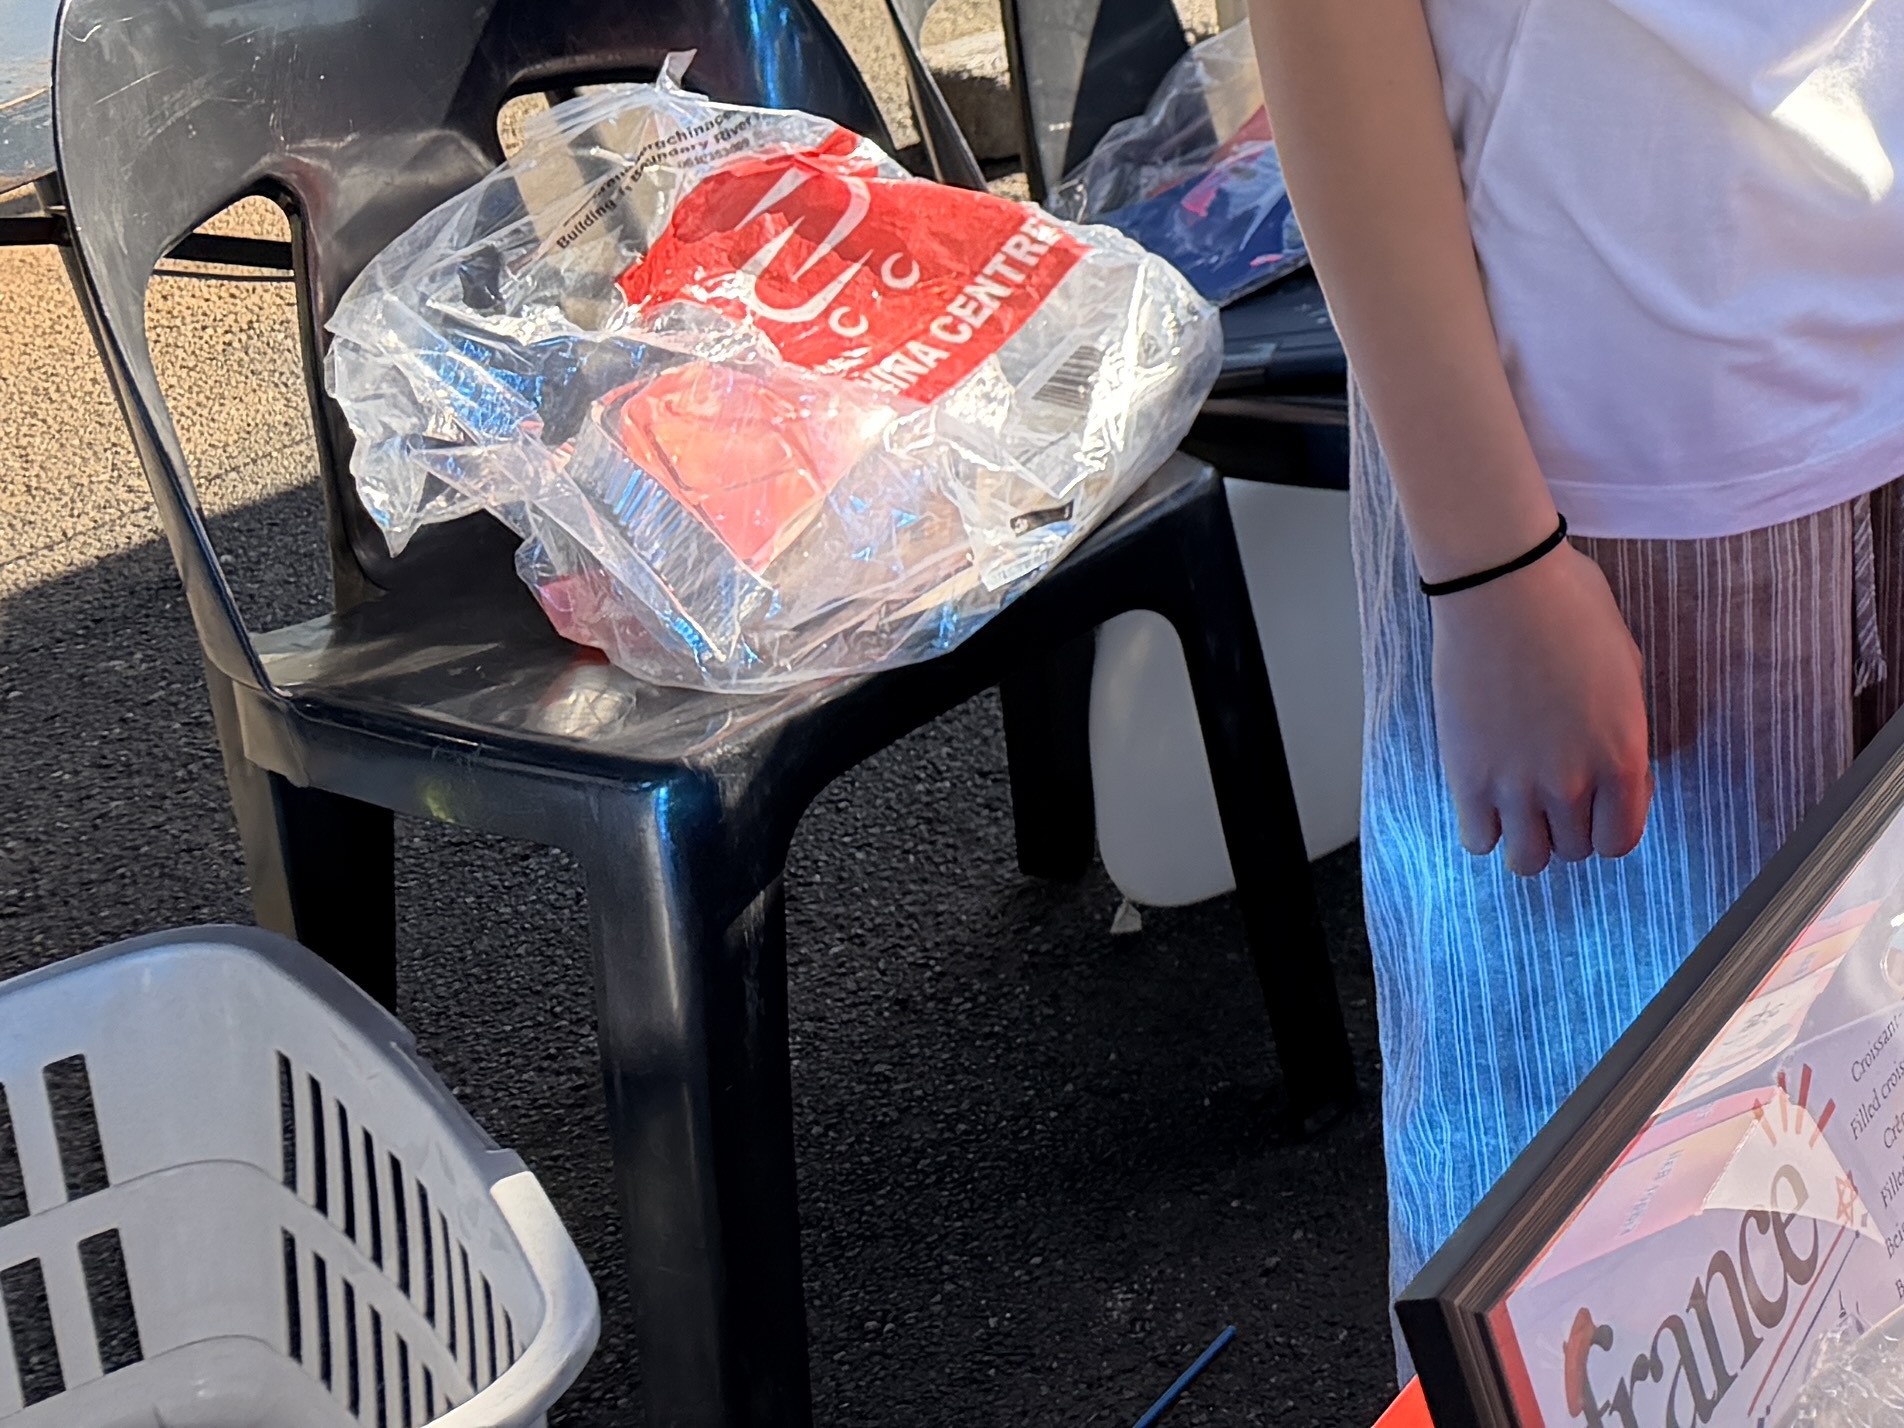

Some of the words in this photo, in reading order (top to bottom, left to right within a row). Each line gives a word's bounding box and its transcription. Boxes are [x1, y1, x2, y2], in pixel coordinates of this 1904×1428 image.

[556, 197, 618, 250] Building
[713, 117, 755, 144] River
[856, 339, 951, 395] HINA
[929, 217, 1063, 344] CENTRE
[881, 252, 921, 290] C
[1849, 1095, 1881, 1142] Filled
[1563, 1163, 1820, 1428] france
